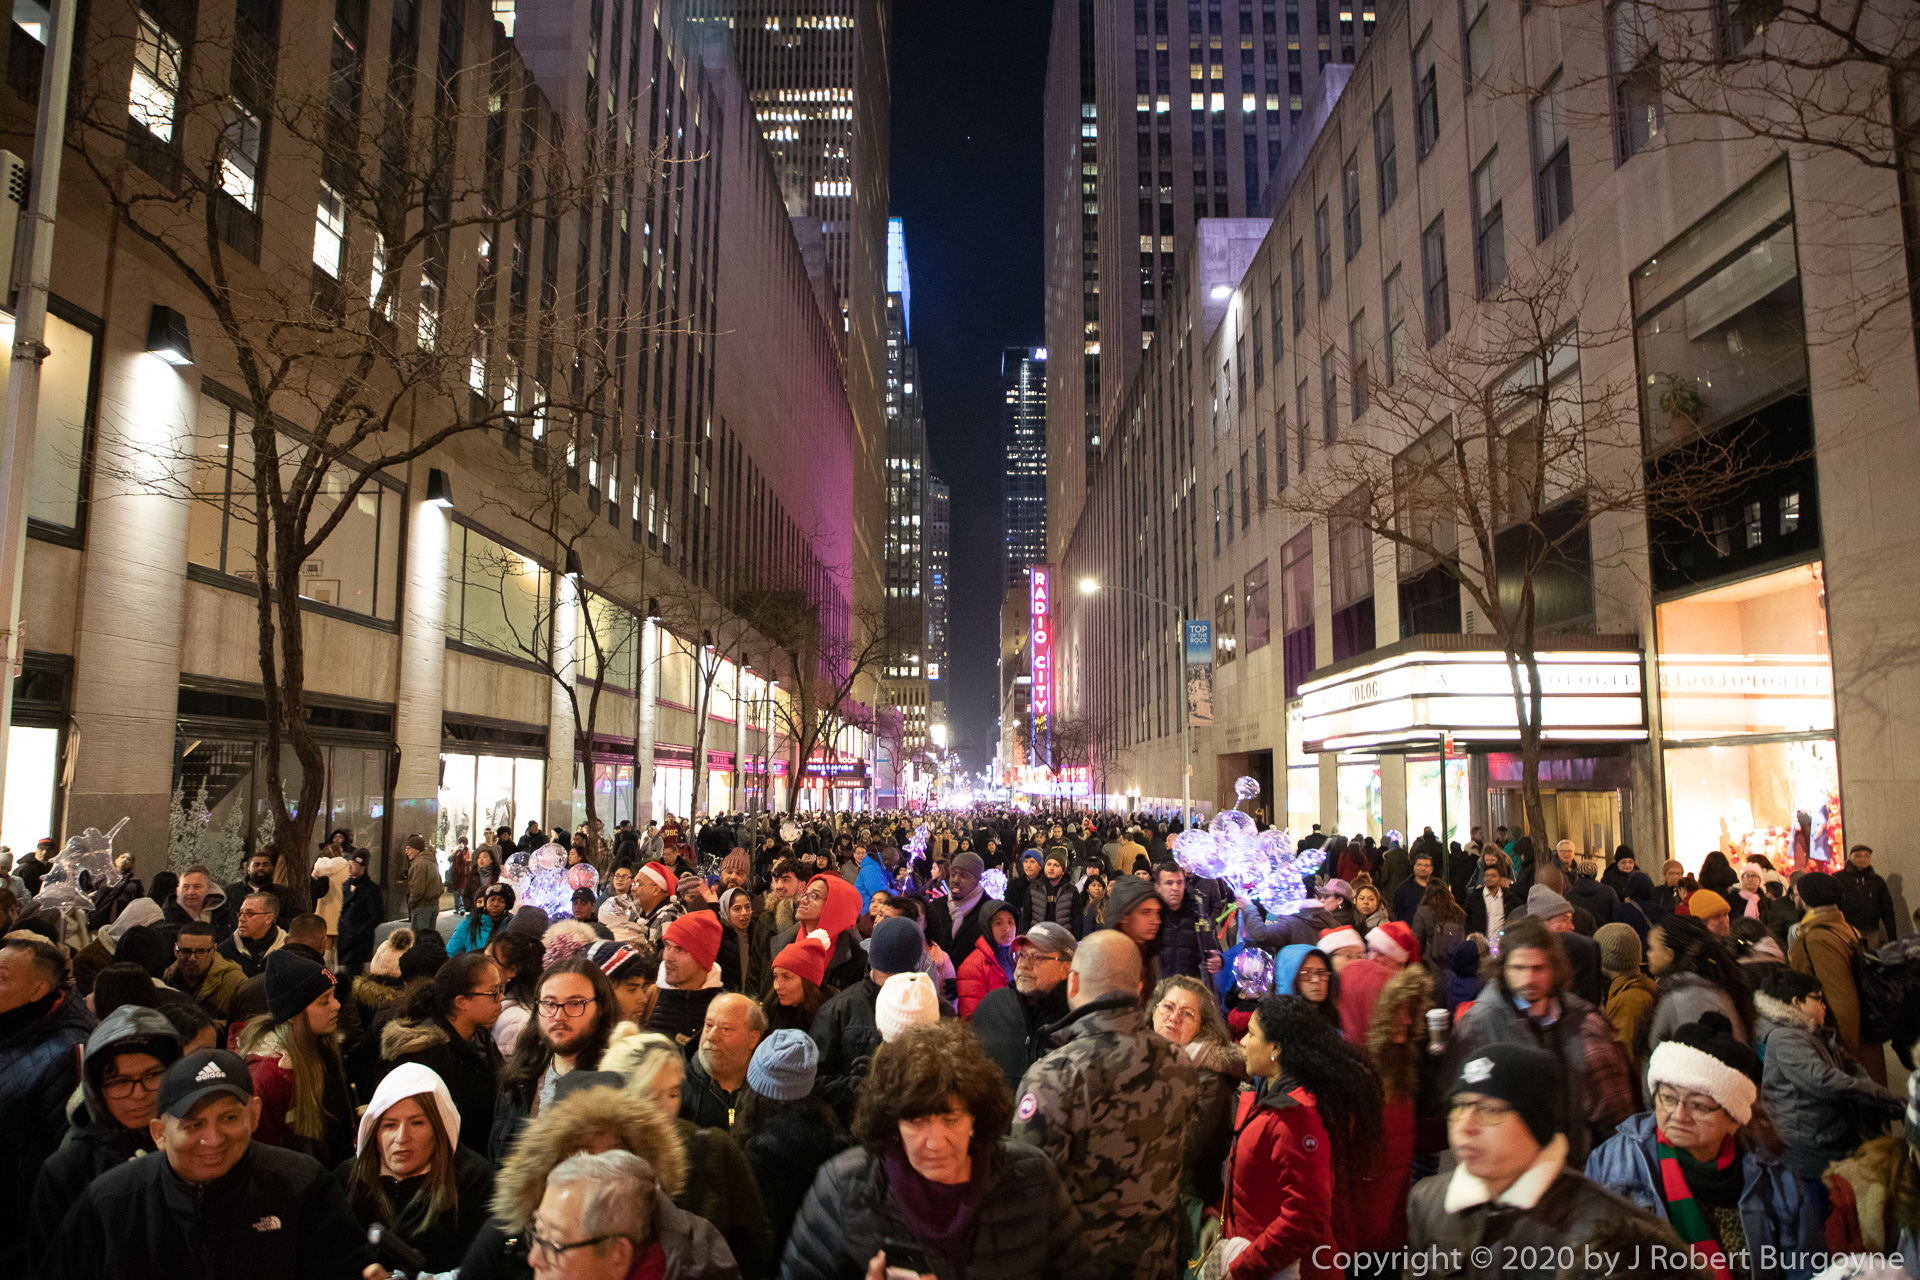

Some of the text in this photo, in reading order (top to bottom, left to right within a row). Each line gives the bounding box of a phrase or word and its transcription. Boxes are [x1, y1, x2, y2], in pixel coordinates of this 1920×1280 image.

[1189, 625, 1208, 633] TOP
[1034, 571, 1047, 713] RADIO CITY
[195, 1071, 226, 1082] adidas
